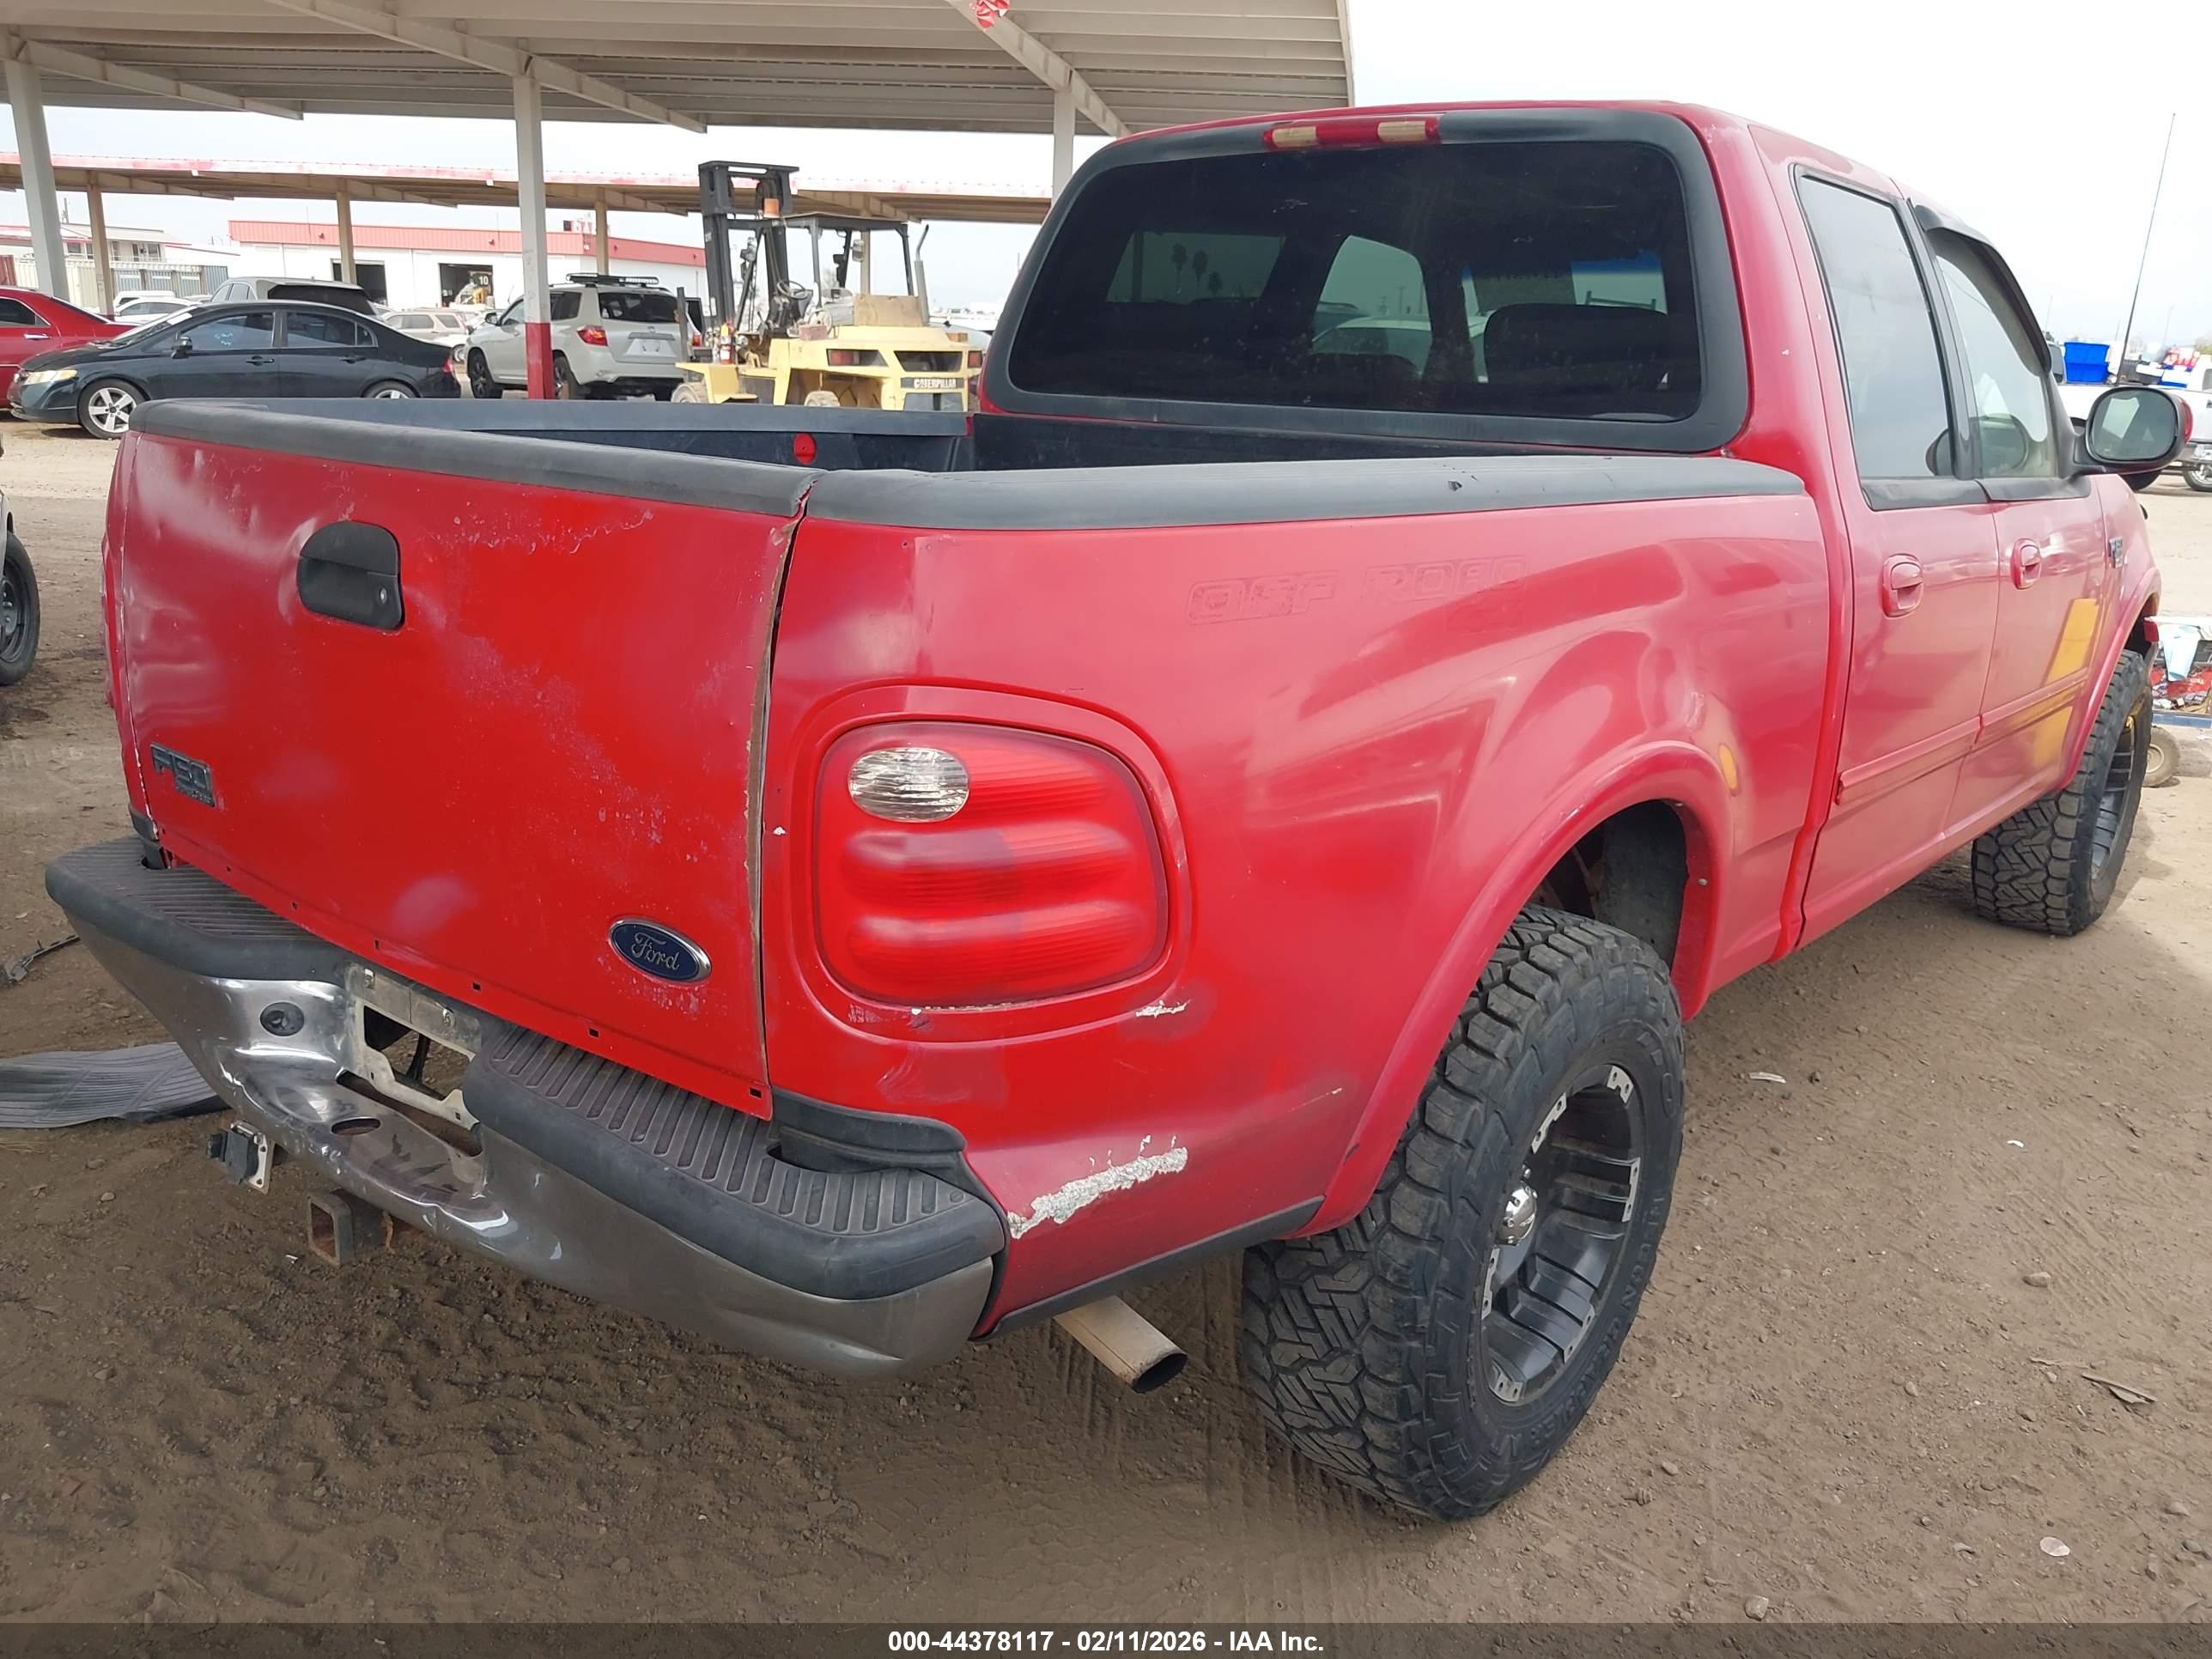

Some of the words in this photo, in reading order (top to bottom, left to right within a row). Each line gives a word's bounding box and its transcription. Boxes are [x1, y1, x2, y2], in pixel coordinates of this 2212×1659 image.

[478, 276, 489, 285] 10
[913, 378, 957, 388] CATERPILLAR
[631, 932, 680, 970] Ford
